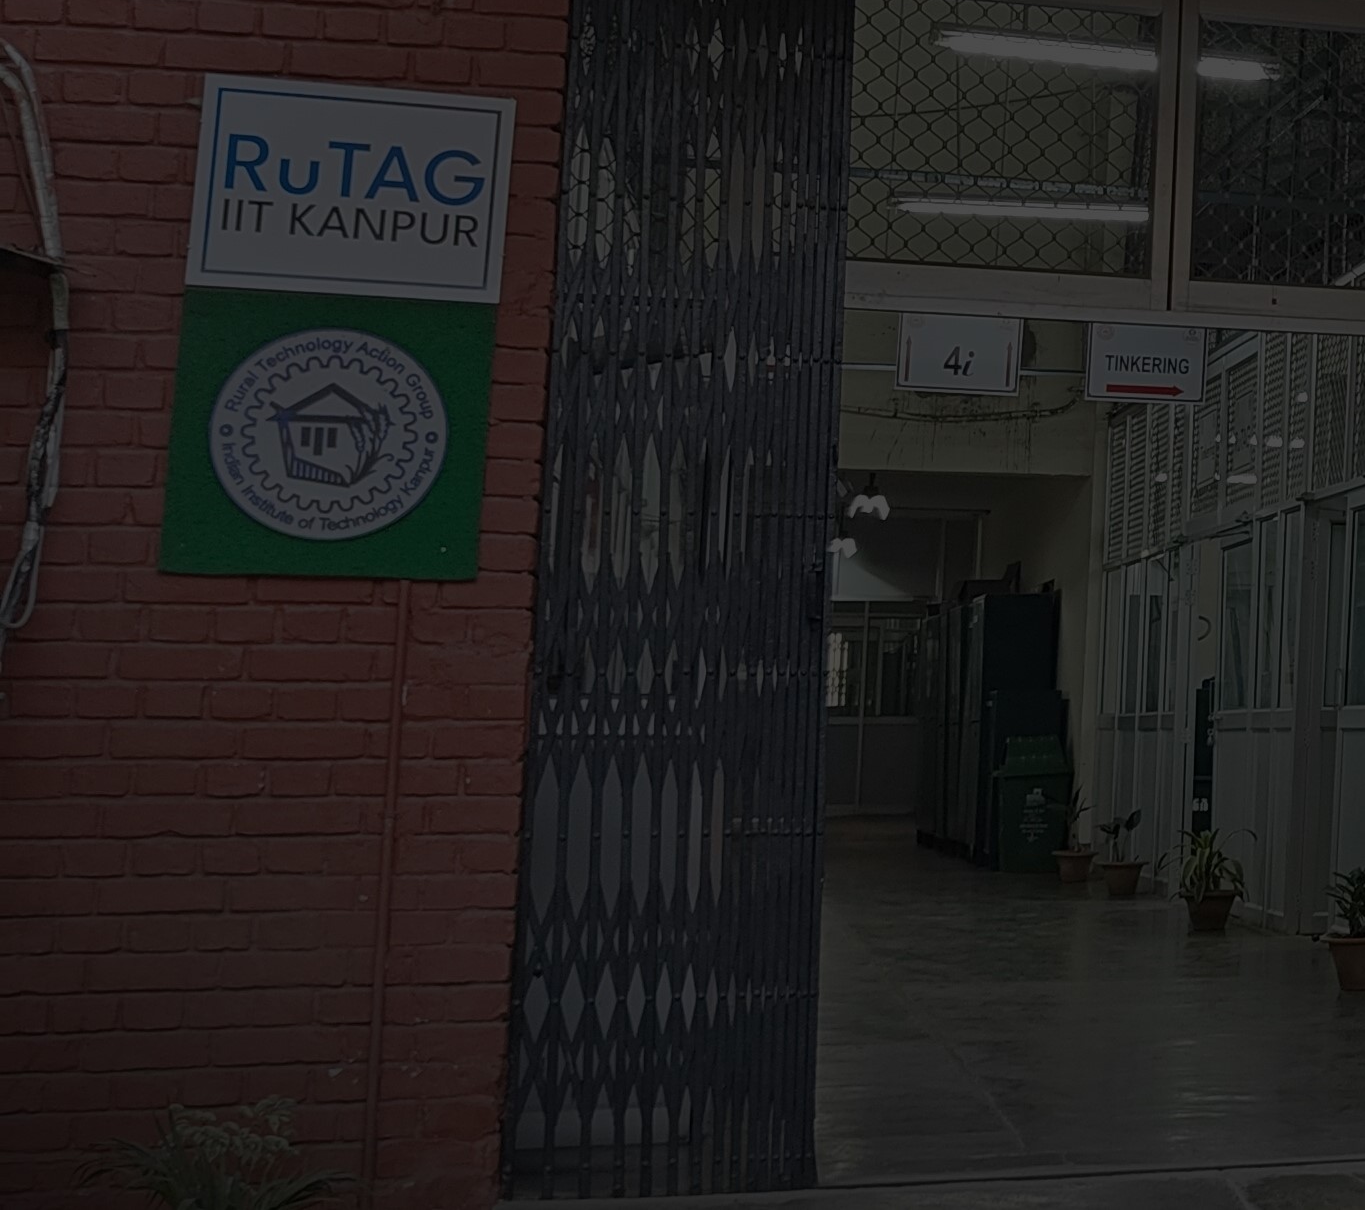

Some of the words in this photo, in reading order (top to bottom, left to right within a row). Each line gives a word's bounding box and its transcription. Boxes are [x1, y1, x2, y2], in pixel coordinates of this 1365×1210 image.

[224, 134, 486, 206] RuTAG
[221, 198, 273, 232] IIT
[289, 203, 479, 247] KANPUR
[224, 370, 259, 413] Rural
[255, 337, 353, 372] Technology
[356, 341, 406, 375] Action
[405, 373, 435, 420] Group
[943, 346, 975, 377] 4i
[1105, 354, 1190, 374] TINKERING
[221, 443, 245, 486] Indian
[241, 484, 294, 525] Institute
[298, 516, 316, 531] of
[320, 494, 404, 532] Technology
[402, 447, 435, 498] Kanpur
